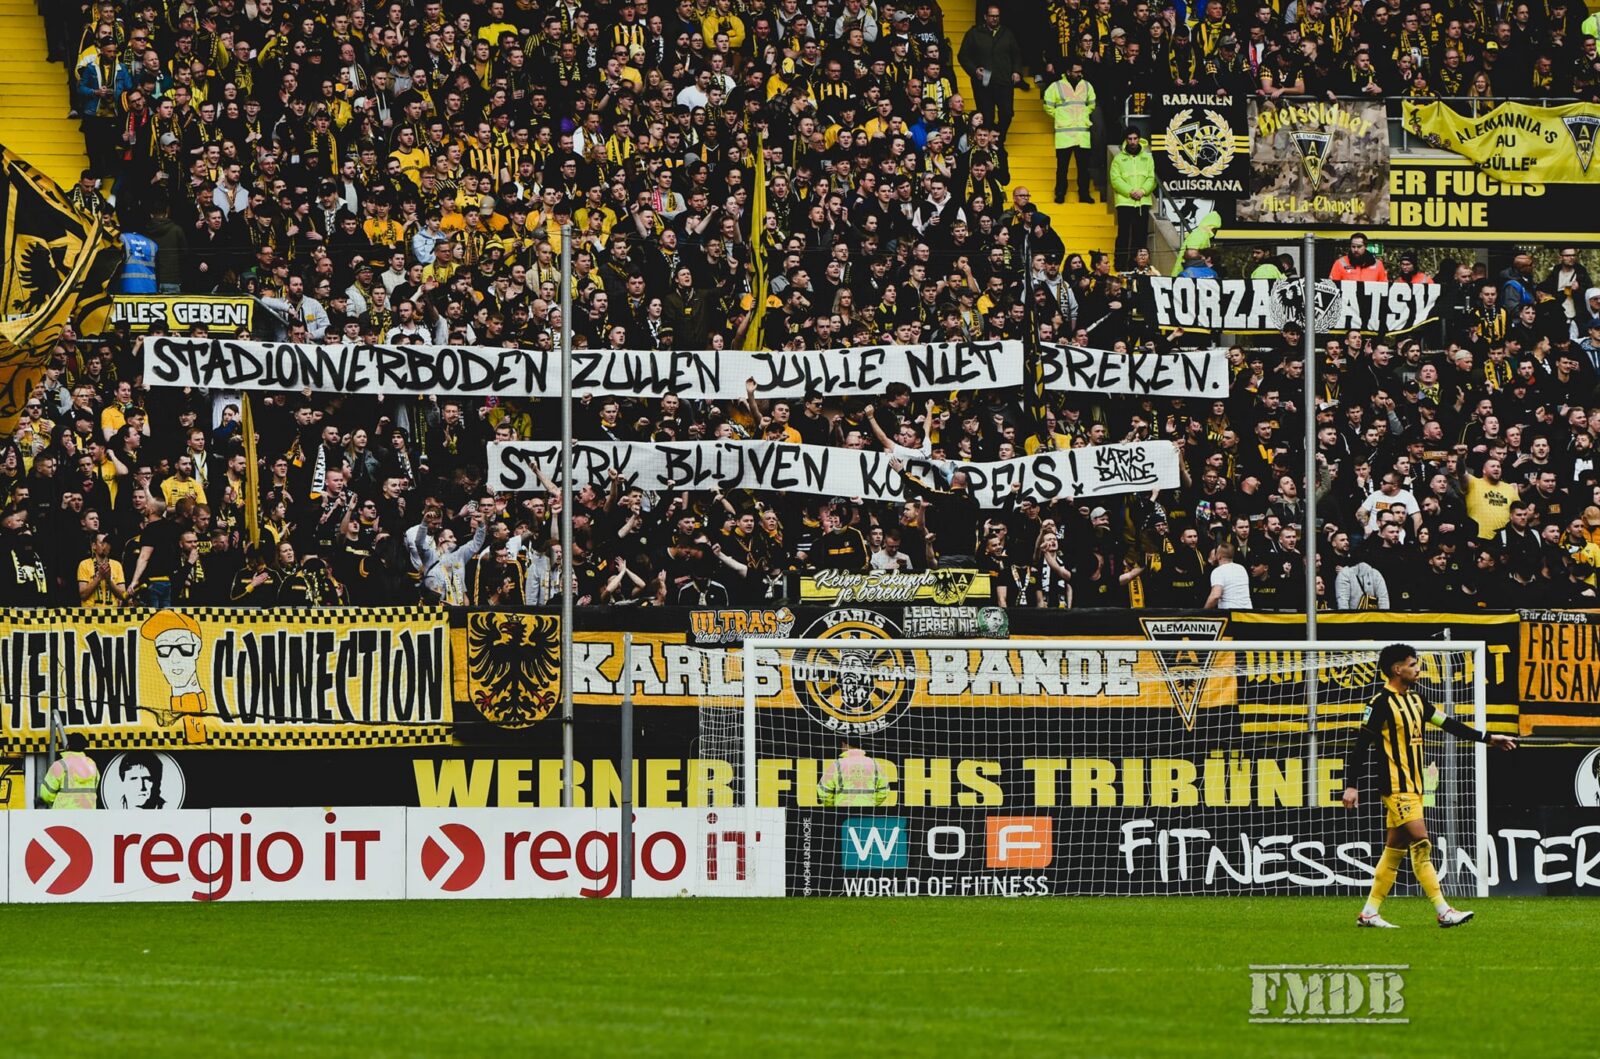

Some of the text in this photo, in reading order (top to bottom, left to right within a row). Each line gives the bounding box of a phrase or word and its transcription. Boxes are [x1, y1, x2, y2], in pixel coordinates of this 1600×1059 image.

[1162, 94, 1233, 107] RABAUKEN
[1495, 134, 1516, 148] AU
[112, 303, 248, 325] LLES GEBEN!
[1150, 276, 1441, 331] FORZA ATSV
[571, 350, 720, 395] ZULLEN
[1037, 344, 1220, 393] BREKEN.
[1096, 446, 1146, 465] KARLS
[1093, 461, 1159, 482] BANDE
[690, 610, 778, 634] ULTRAS
[823, 608, 887, 629] KARLS
[1521, 609, 1541, 620] Für
[1542, 609, 1556, 620] die
[1152, 623, 1218, 633] ALEMANNIA
[0, 625, 443, 729] YELLOW CONNECTION
[572, 643, 1142, 698] KARLS BANDE
[412, 758, 736, 808] WERNER
[1021, 750, 1345, 808] TRIBÜNE
[113, 812, 304, 900] regio
[504, 812, 687, 898] regio
[1120, 820, 1374, 887] FITNESS
[842, 875, 1049, 898] WORLD OF FITNESS
